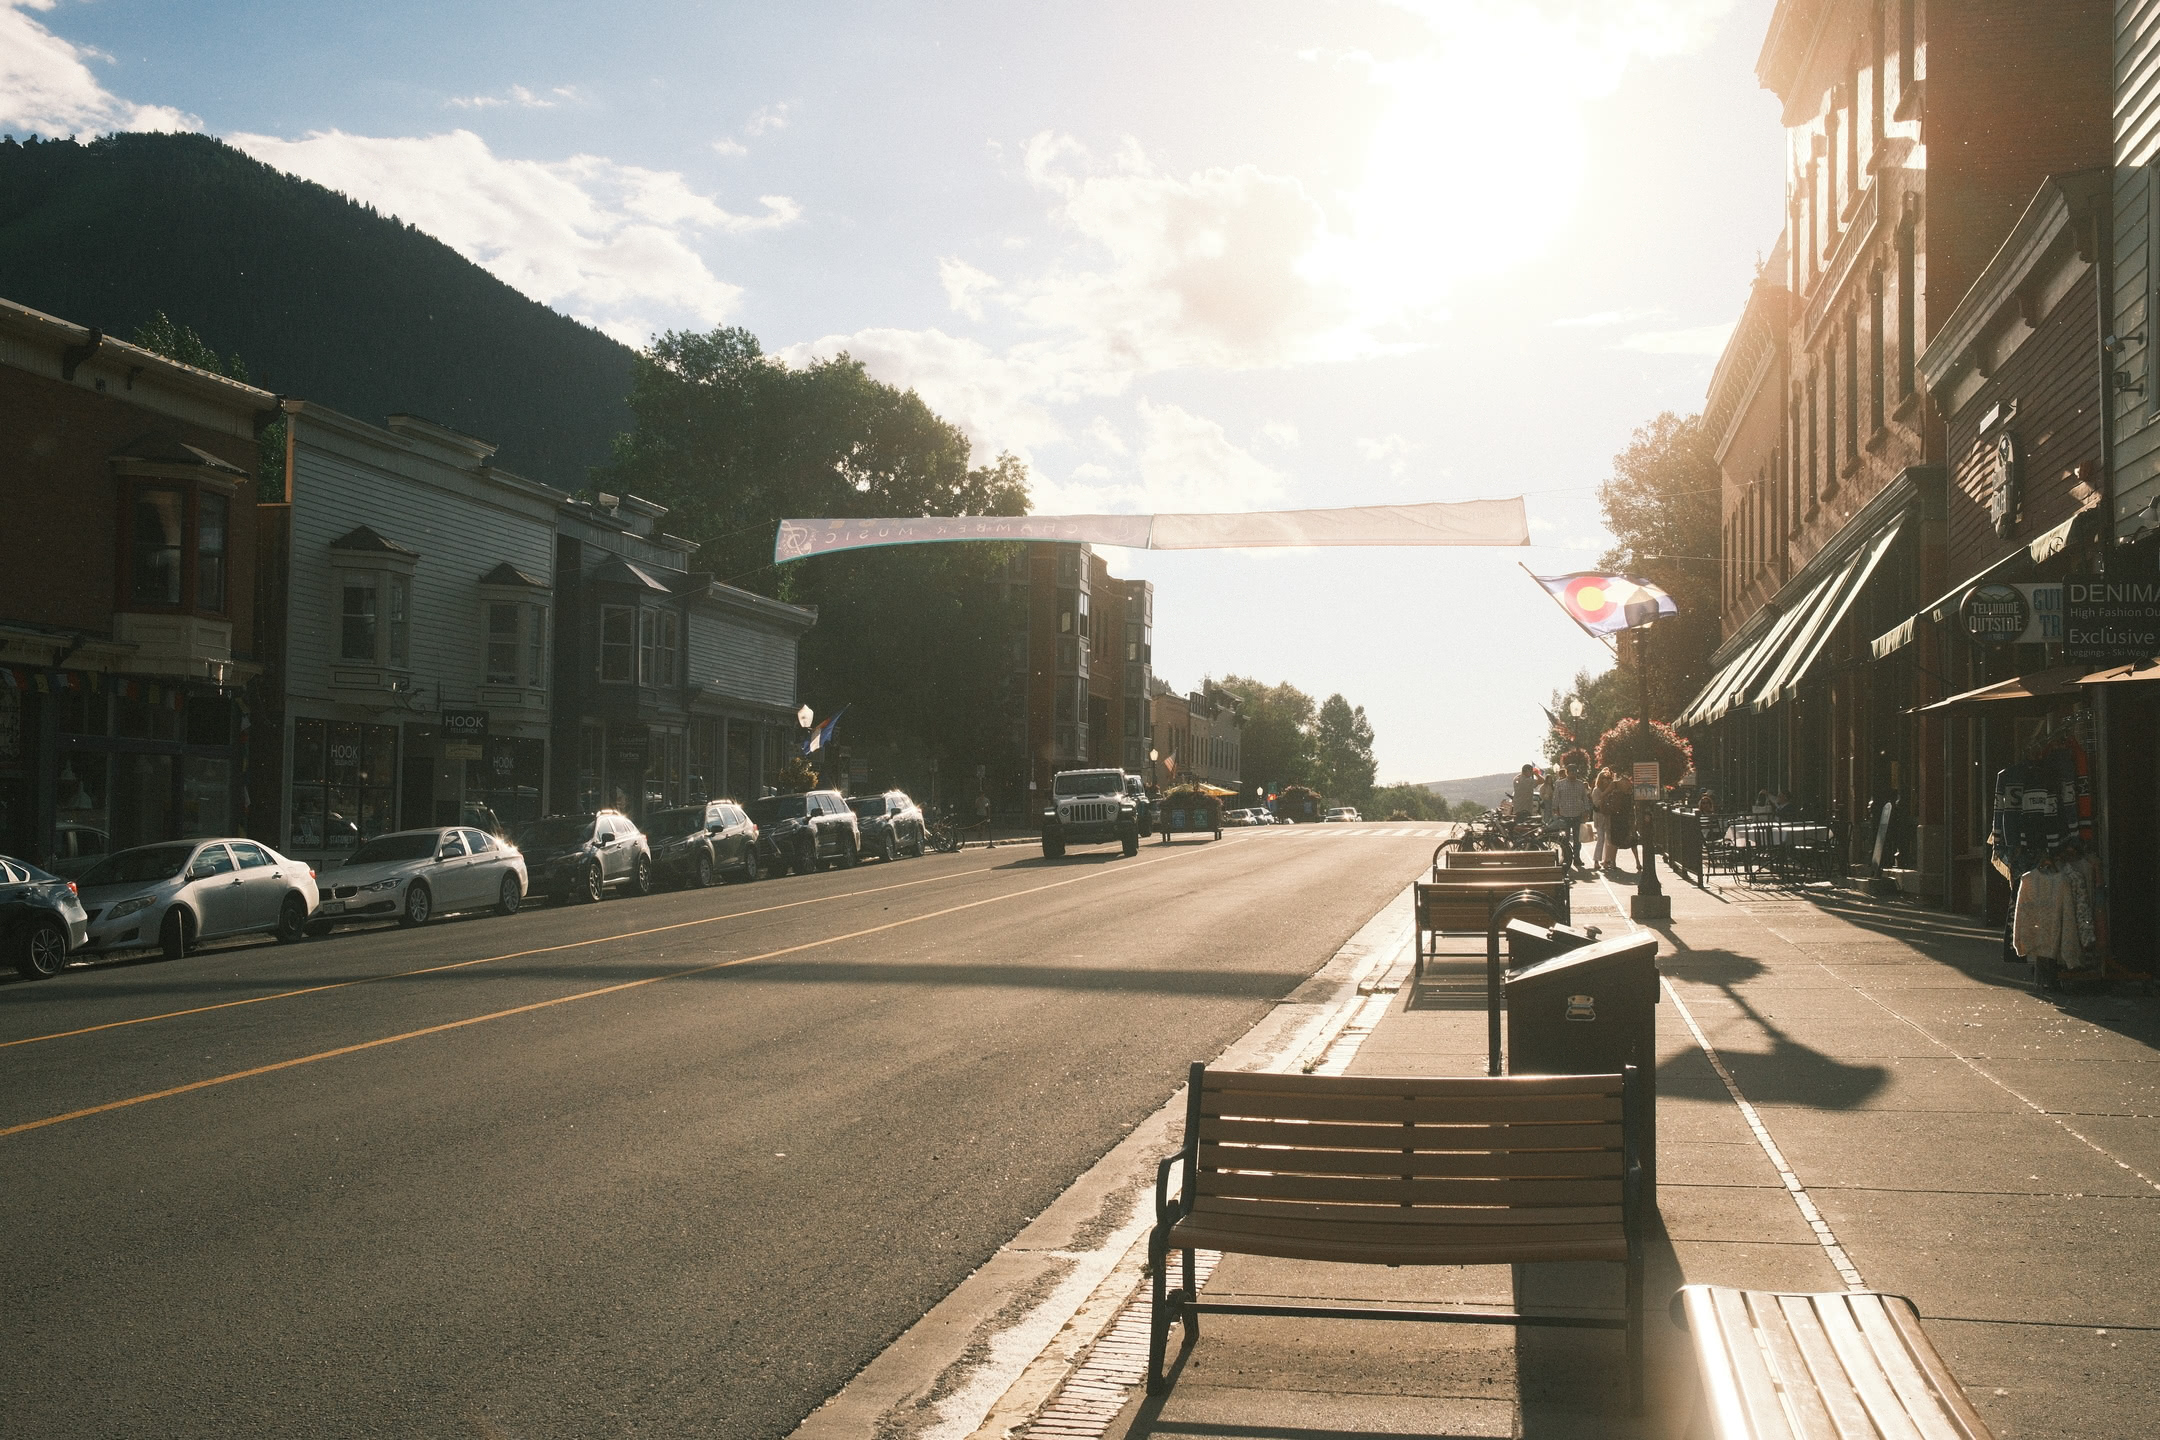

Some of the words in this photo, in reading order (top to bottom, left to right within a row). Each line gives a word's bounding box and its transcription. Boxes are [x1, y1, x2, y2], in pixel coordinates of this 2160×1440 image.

[1972, 602, 2019, 614] TELLURIDE
[2070, 608, 2095, 619] High
[2100, 608, 2141, 617] Fashion
[1969, 616, 2022, 632] OUTSIDE
[2070, 629, 2155, 645] Exclusive
[2069, 649, 2105, 658] Leggings
[2112, 649, 2124, 657] Ski
[2127, 649, 2149, 658] Wear
[445, 716, 484, 728] HOOK
[330, 744, 359, 759] HOOK
[493, 756, 514, 769] HOOK
